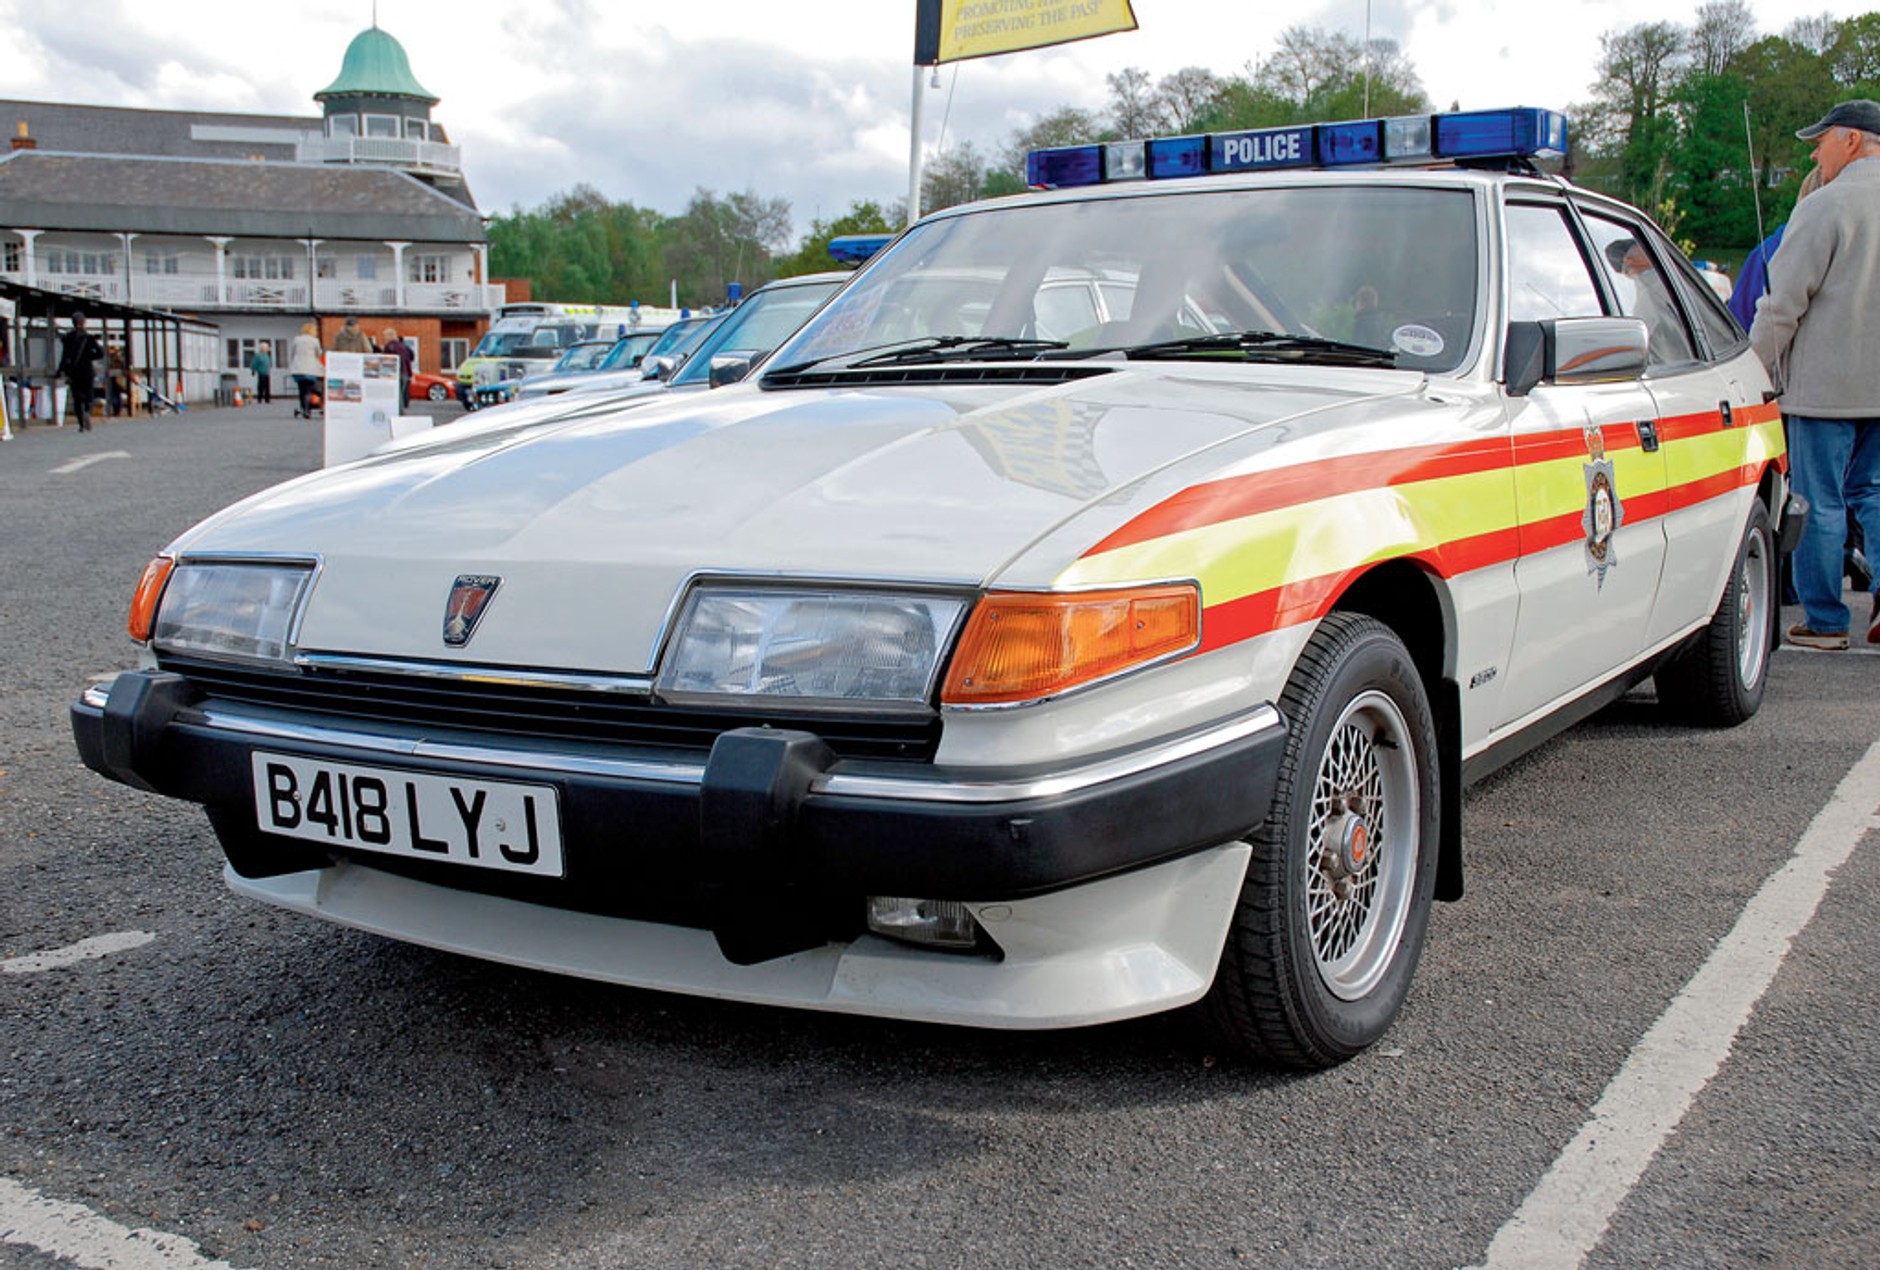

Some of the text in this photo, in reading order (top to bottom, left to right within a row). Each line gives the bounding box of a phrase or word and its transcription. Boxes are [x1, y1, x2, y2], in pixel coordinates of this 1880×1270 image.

[954, 14, 1035, 40] PRESERVING
[1038, 7, 1066, 26] THE
[1070, 1, 1102, 20] PAST
[955, 0, 1034, 21] PROMOTING
[1224, 133, 1301, 165] POLICE
[457, 575, 497, 585] ROVER
[266, 762, 540, 865] B418 LYJ
